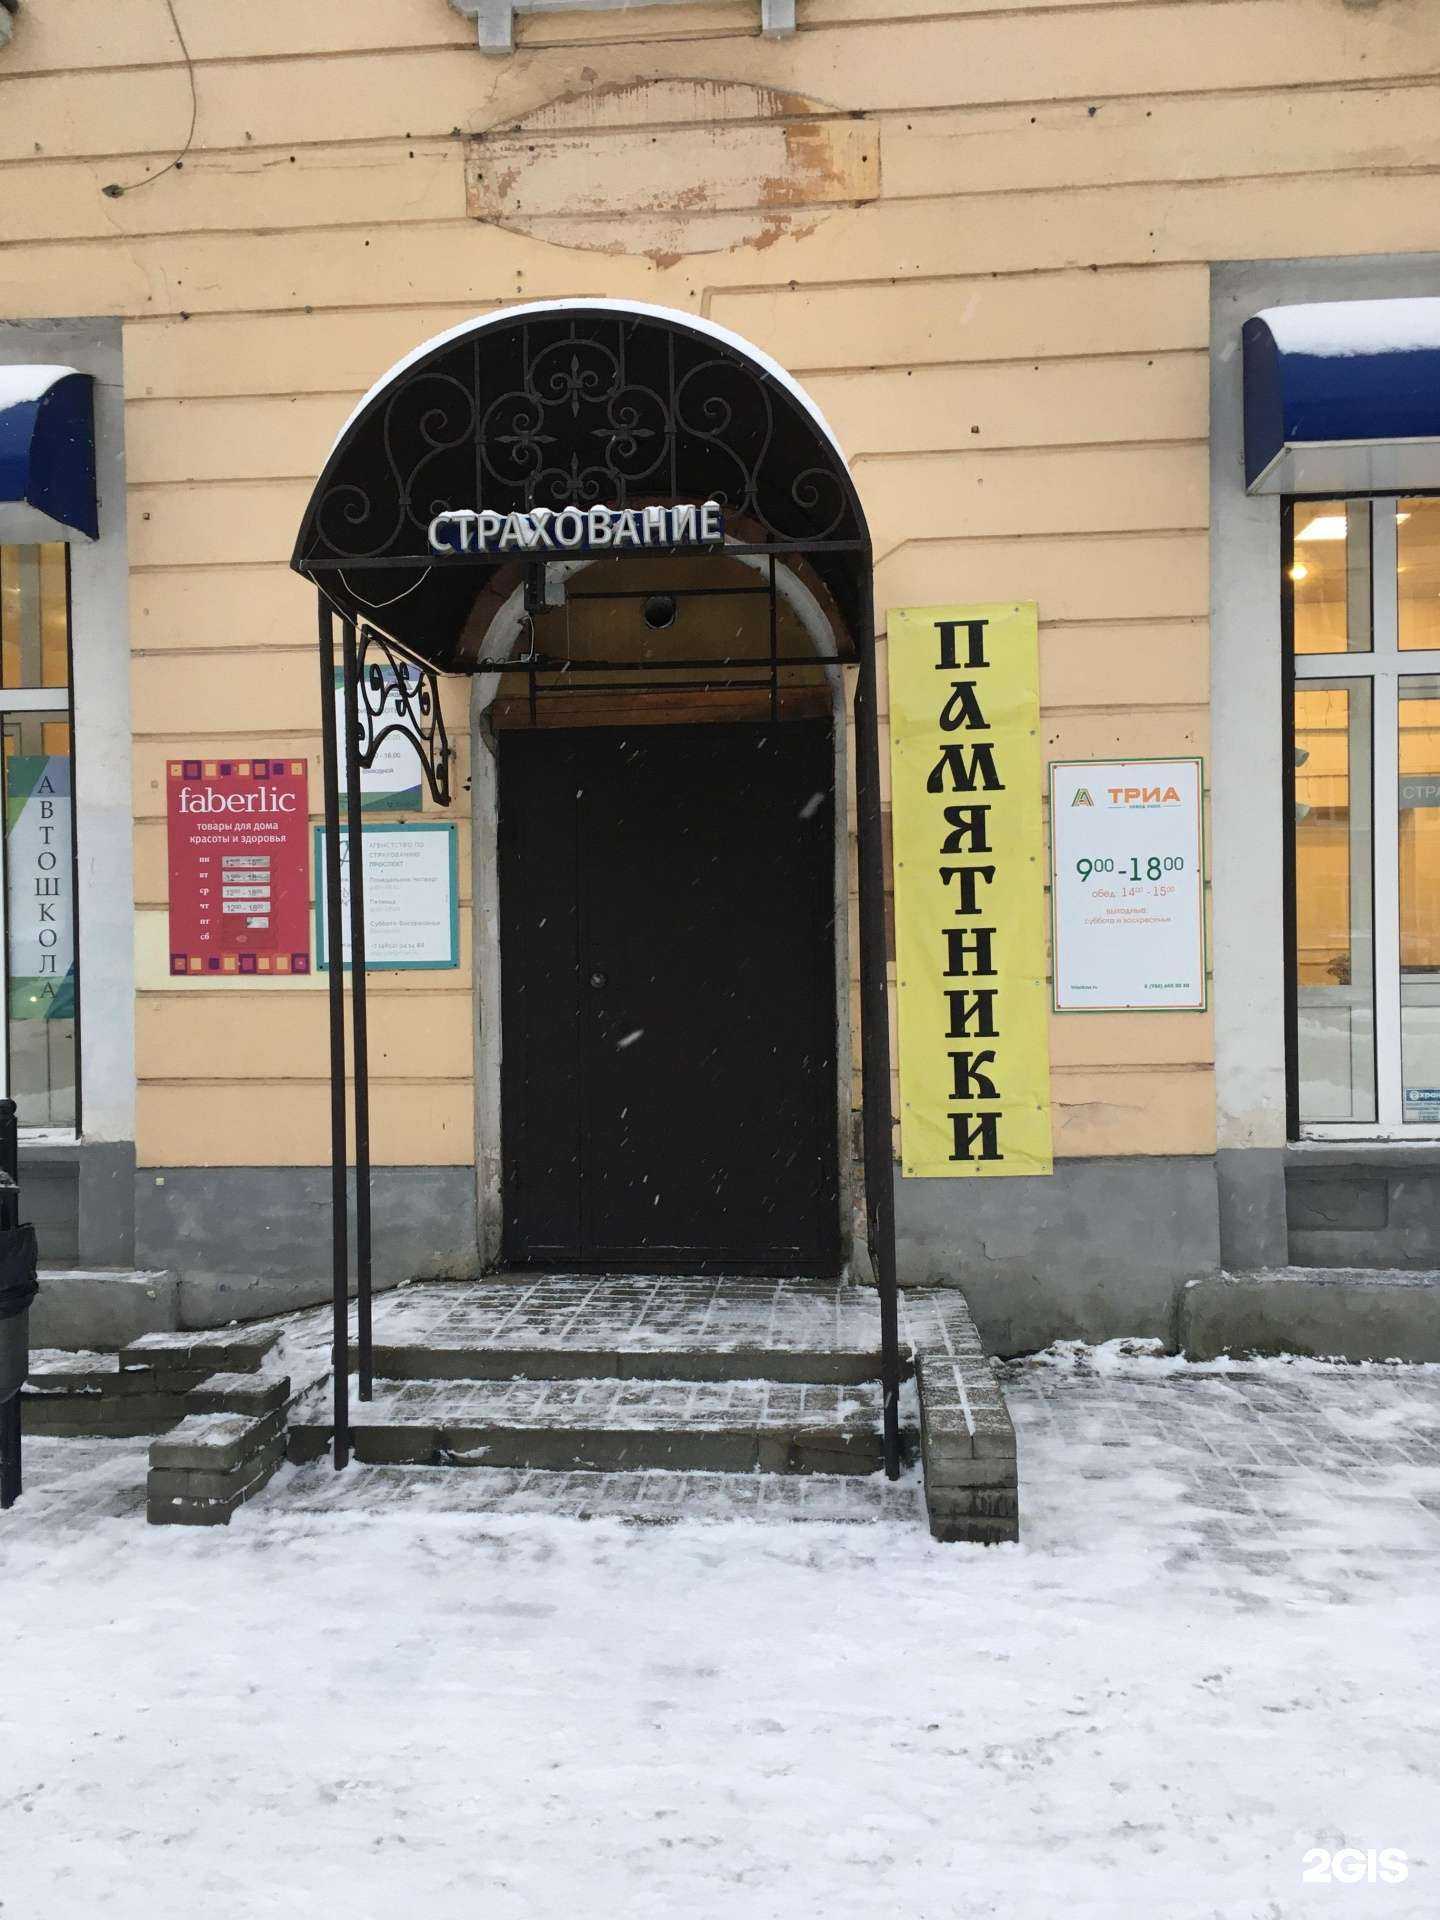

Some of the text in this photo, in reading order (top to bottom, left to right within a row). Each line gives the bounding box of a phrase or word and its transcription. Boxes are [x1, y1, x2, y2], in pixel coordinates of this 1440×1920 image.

[428, 506, 723, 551] СТРАХОВАНИЕ
[179, 786, 296, 813] faberlic
[1108, 786, 1181, 803] ТРИА
[196, 822, 279, 831] товары для дома
[190, 835, 230, 844] красоты
[241, 835, 287, 845] здоровья
[34, 775, 61, 999] АВТОШКОЛА
[927, 619, 1005, 1161] ПАМЯТНИКИ
[1092, 888, 1116, 898] обед
[200, 932, 210, 940] сб
